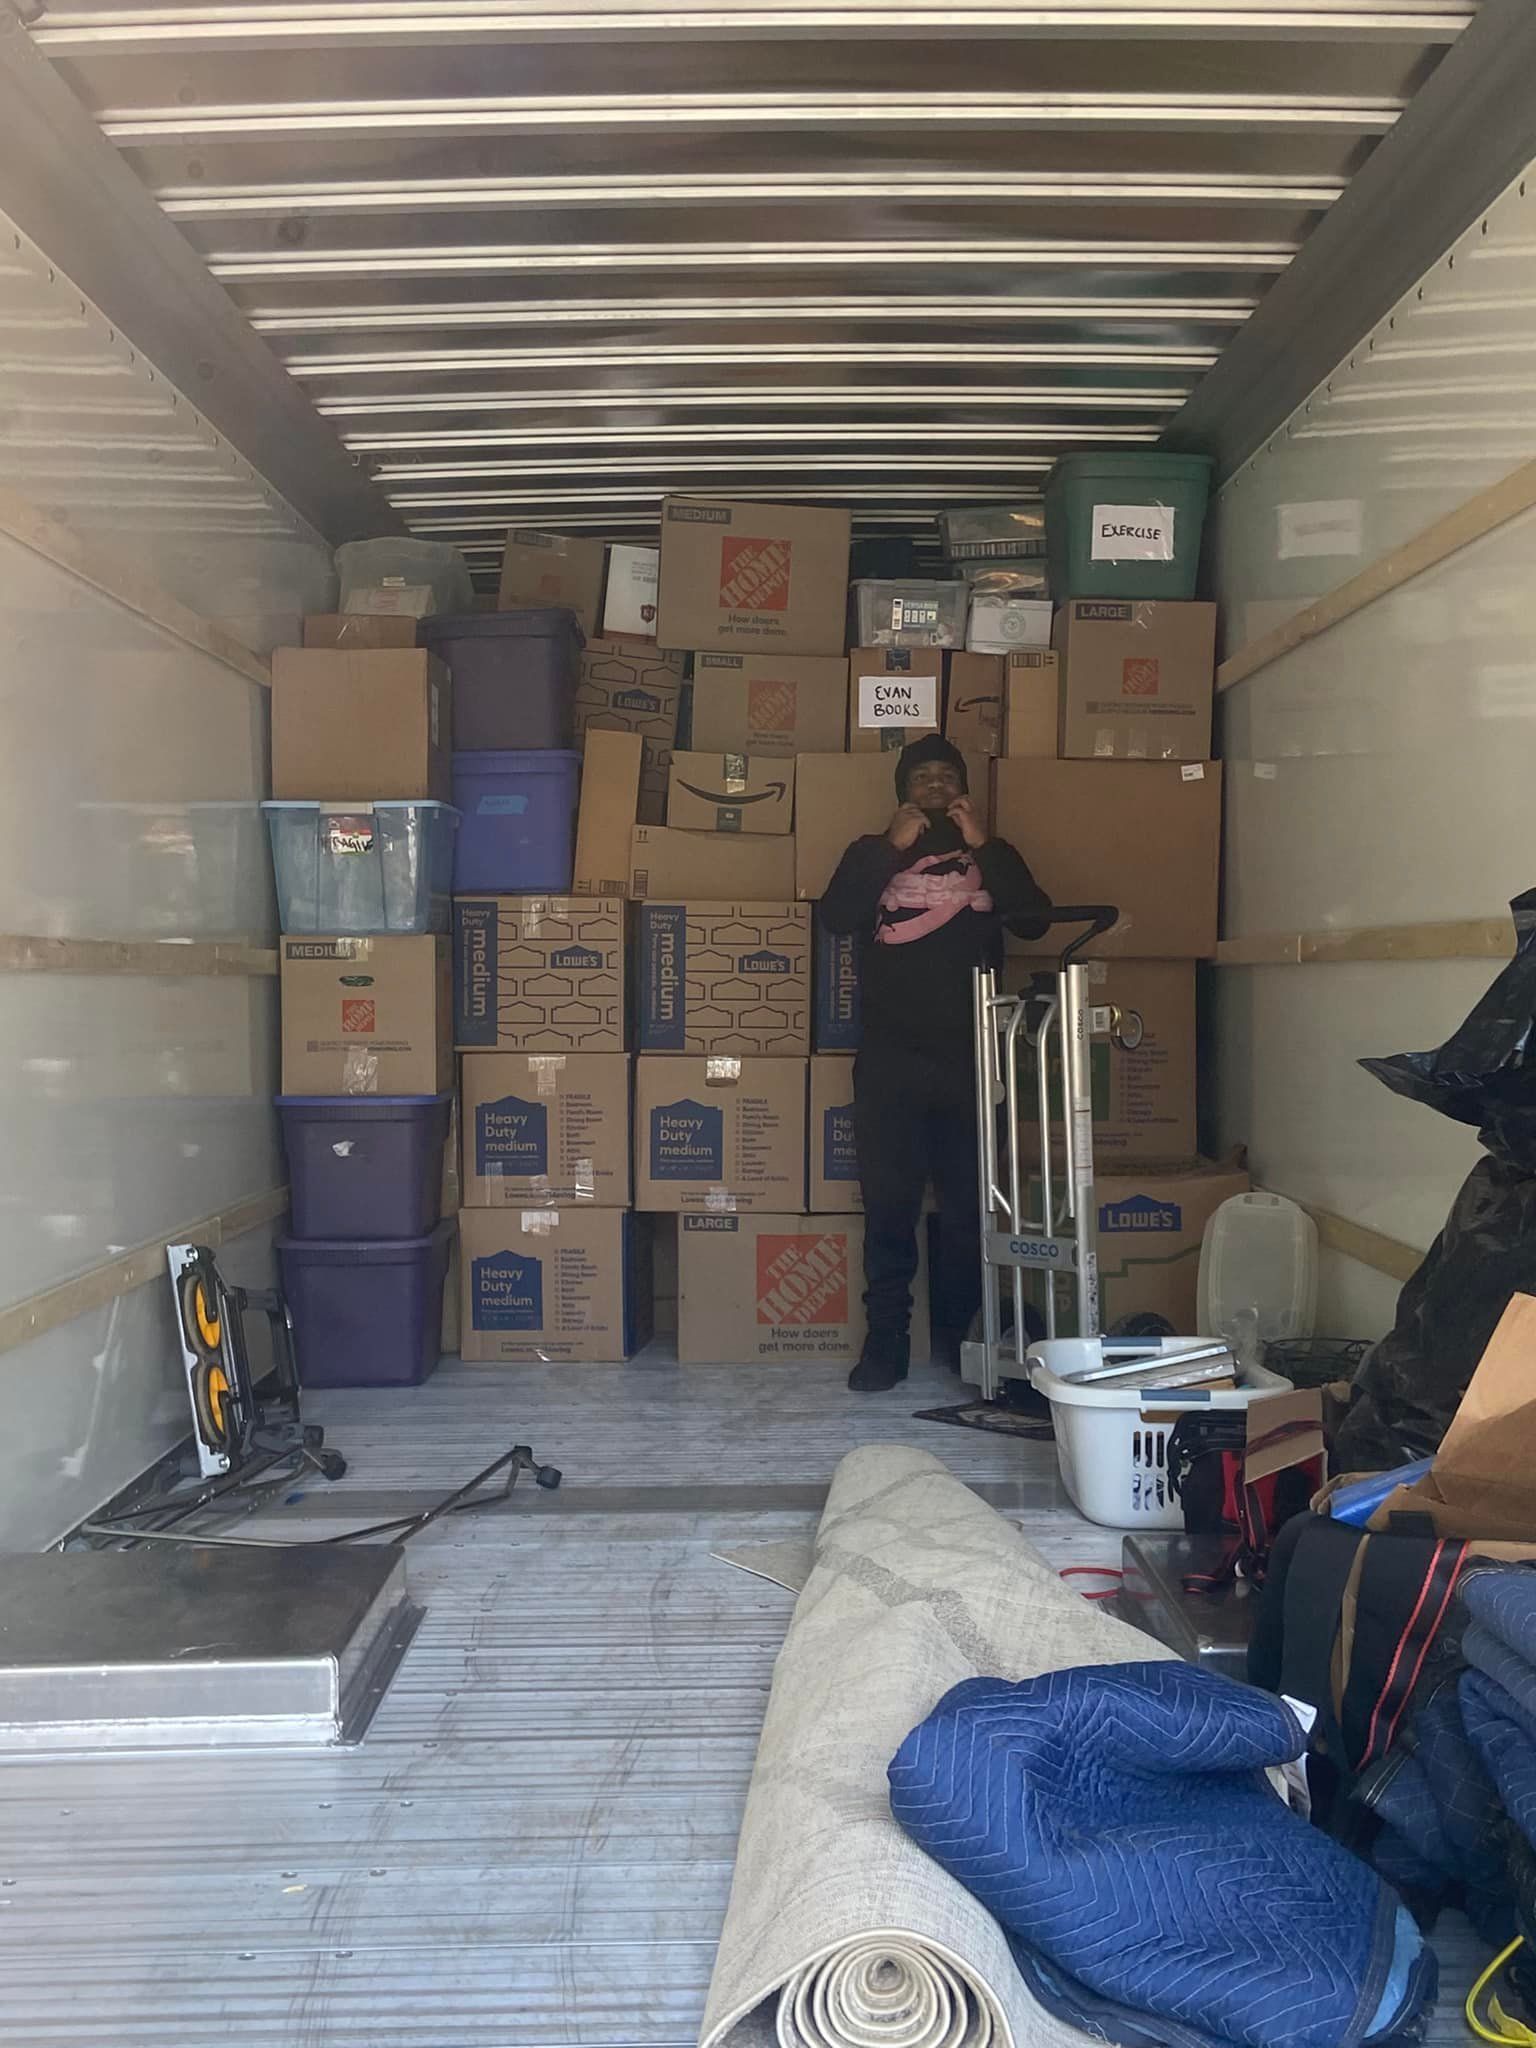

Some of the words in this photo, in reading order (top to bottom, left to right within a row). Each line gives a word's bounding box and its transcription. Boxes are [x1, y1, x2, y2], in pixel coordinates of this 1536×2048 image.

[671, 508, 728, 522] MEDIUM
[1101, 523, 1162, 540] EXERCISE
[728, 545, 760, 573] THE
[720, 538, 792, 607] HOME
[1080, 605, 1127, 618] LARGE
[728, 614, 751, 624] How
[874, 685, 912, 701] EVAN
[873, 703, 920, 717] BOOKS
[461, 909, 491, 919] Heavy
[650, 912, 680, 922] Heavy
[461, 918, 485, 927] Duty
[650, 921, 673, 931] Duty
[291, 944, 352, 957] MEDIUM
[555, 953, 599, 968] LOWE'S
[743, 958, 786, 972] LOWE'S
[472, 929, 492, 1017] medium
[660, 933, 680, 1021] medium
[838, 934, 858, 1020] medium
[484, 1113, 529, 1126] Heavy
[659, 1116, 704, 1130] Heavy
[484, 1126, 517, 1139] Duty
[659, 1130, 693, 1143] Duty
[484, 1141, 538, 1152] medium
[659, 1144, 713, 1156] medium
[689, 1217, 733, 1230] LARGE
[1107, 1208, 1174, 1229] LOWE'S
[1009, 1240, 1060, 1258] COSCO
[766, 1244, 803, 1280] THE
[480, 1267, 523, 1281] Heavy
[757, 1234, 848, 1325] HOME
[480, 1281, 513, 1294] Duty
[480, 1294, 533, 1307] medium
[793, 1267, 848, 1323] DEPOT
[771, 1327, 799, 1339] How
[802, 1327, 840, 1339] doers
[758, 1342, 779, 1354] get
[783, 1344, 816, 1352] more
[818, 1341, 853, 1352] done.
